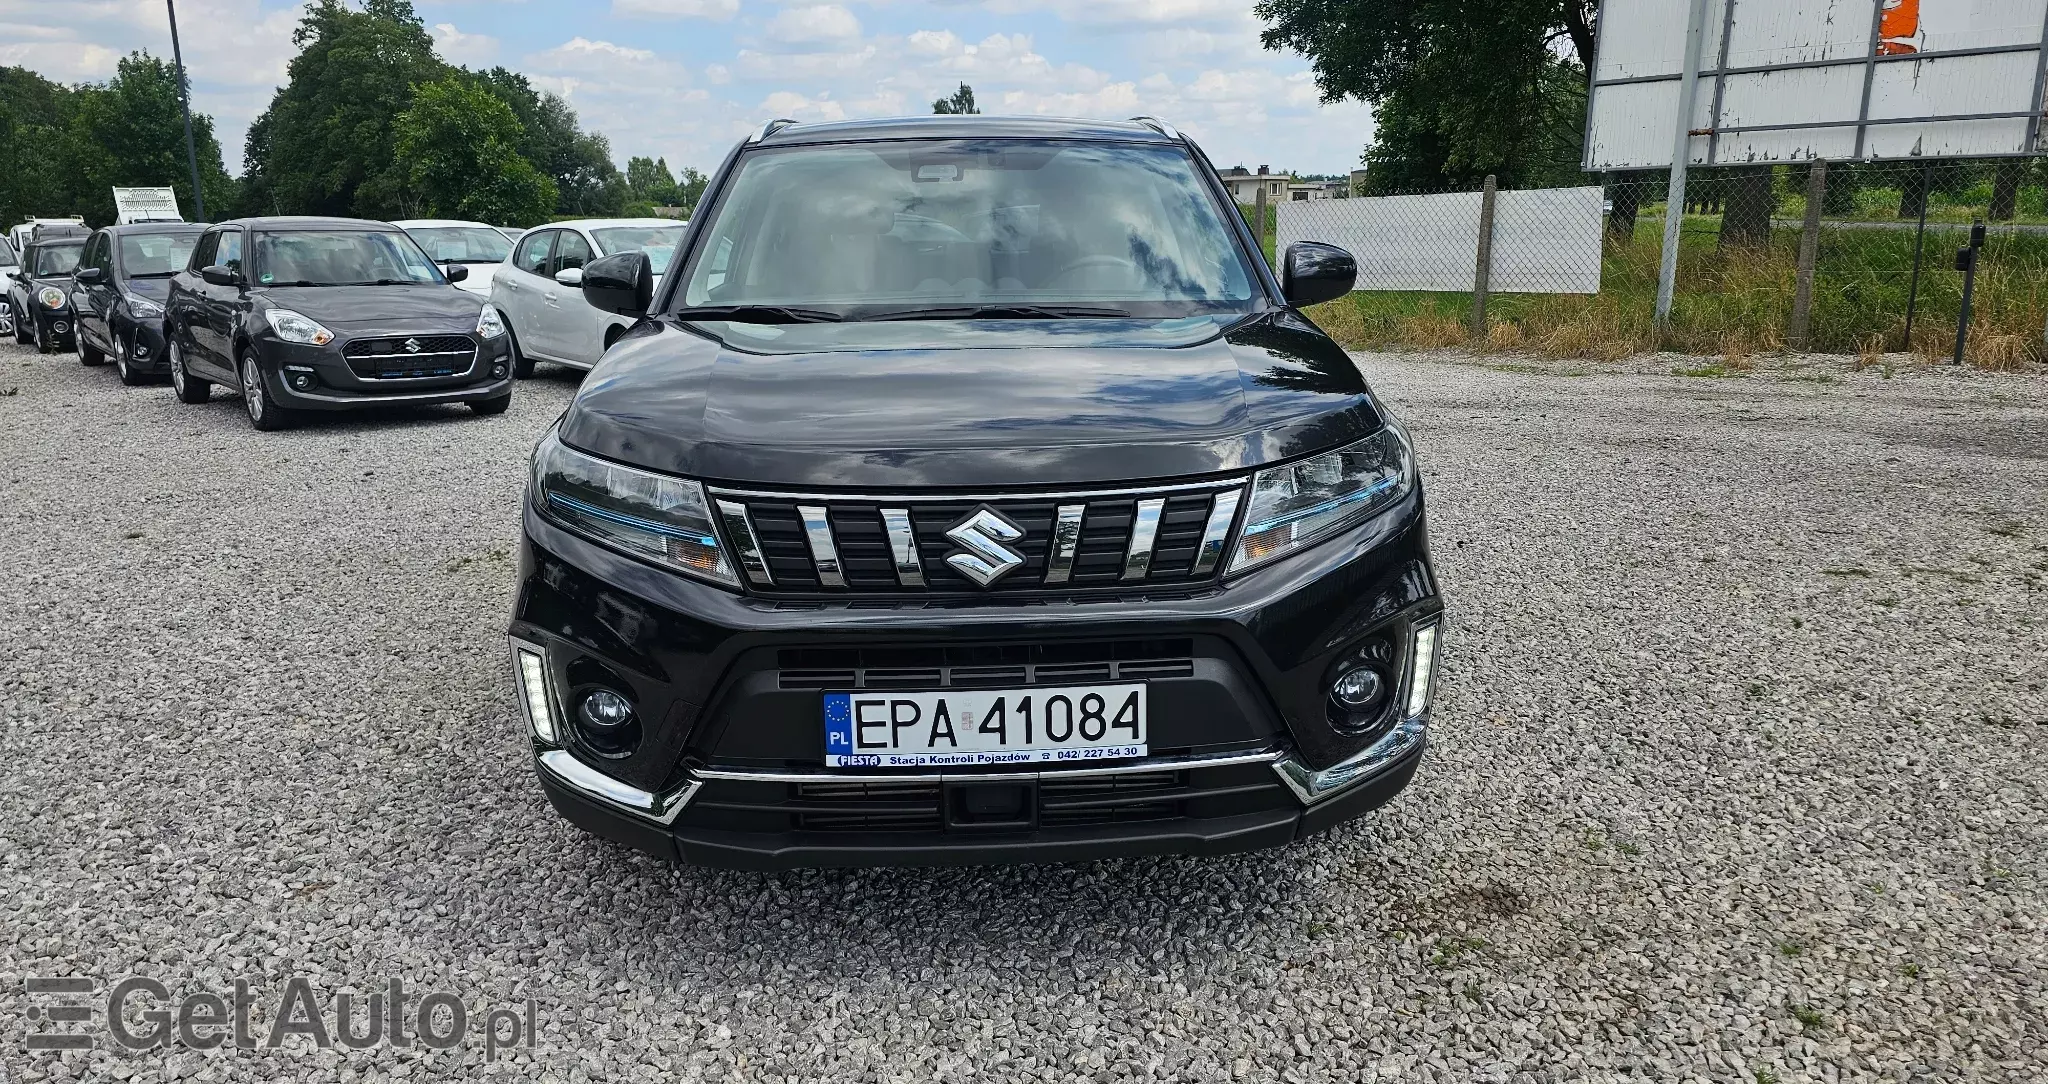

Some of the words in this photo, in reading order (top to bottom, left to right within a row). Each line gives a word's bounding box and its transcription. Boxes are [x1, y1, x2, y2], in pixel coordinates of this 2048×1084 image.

[855, 698, 958, 749] EPA
[978, 690, 1140, 745] 41084
[830, 731, 848, 745] PL
[841, 755, 879, 766] FIESTA
[889, 756, 926, 766] Stacja
[929, 754, 974, 764] Kontroli
[977, 753, 1031, 764] Pojazdów
[1083, 749, 1104, 758] 227
[1107, 748, 1121, 757] 54
[1123, 747, 1138, 756] 30
